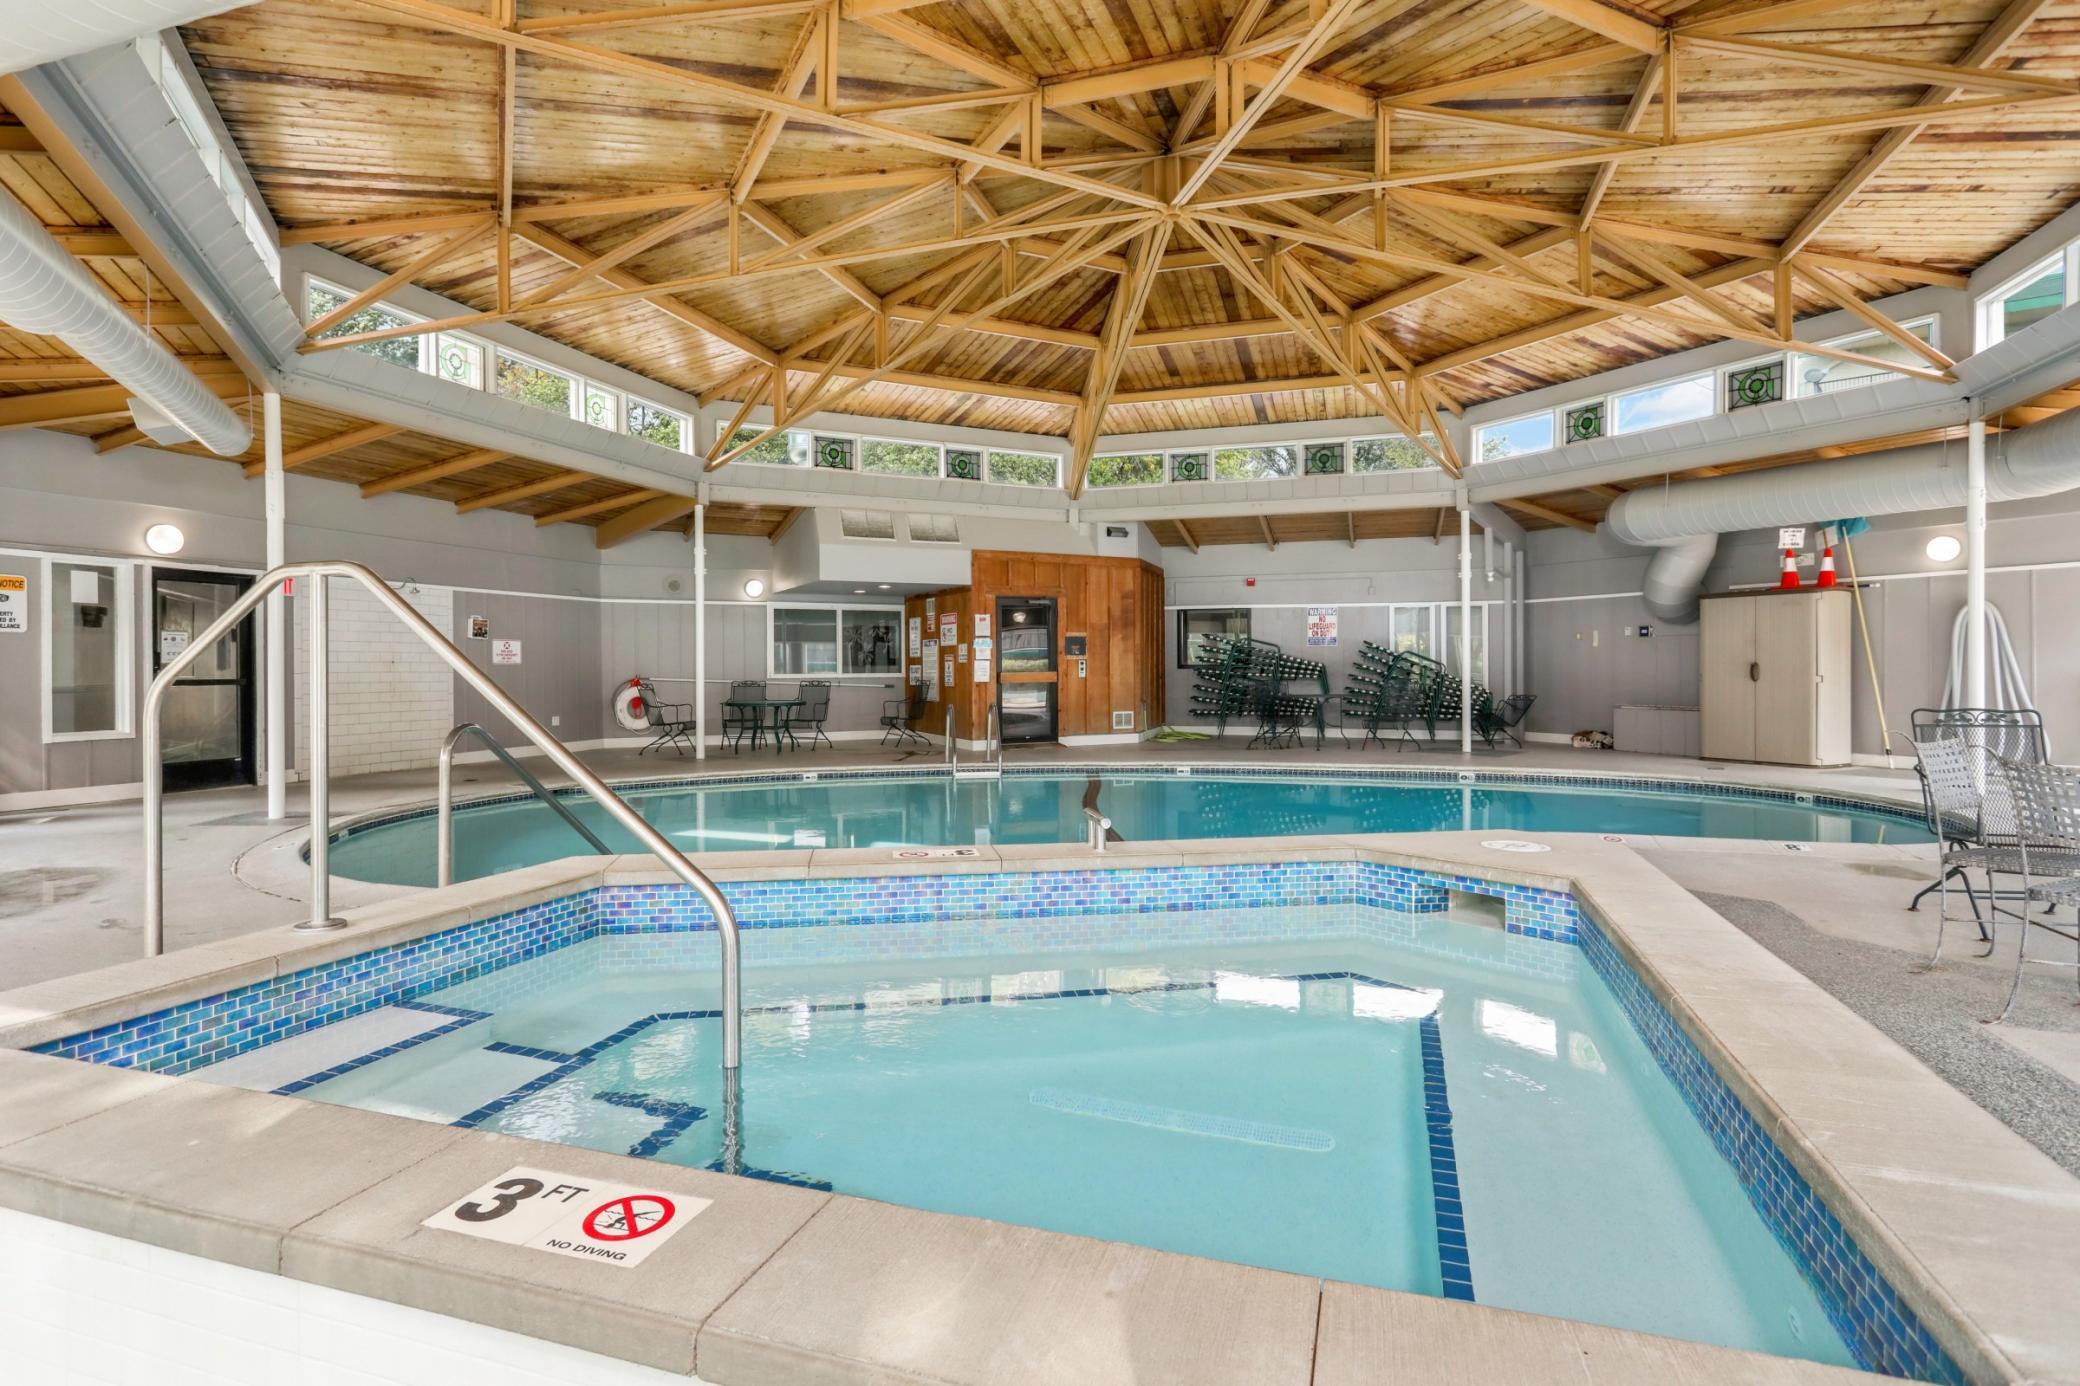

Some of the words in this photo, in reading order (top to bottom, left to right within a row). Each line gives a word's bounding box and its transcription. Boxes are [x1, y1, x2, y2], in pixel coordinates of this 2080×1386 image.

[454, 1178, 544, 1222] 3
[541, 1184, 590, 1203] FT
[546, 1239, 572, 1249] NO
[572, 1244, 627, 1261] DIVING
